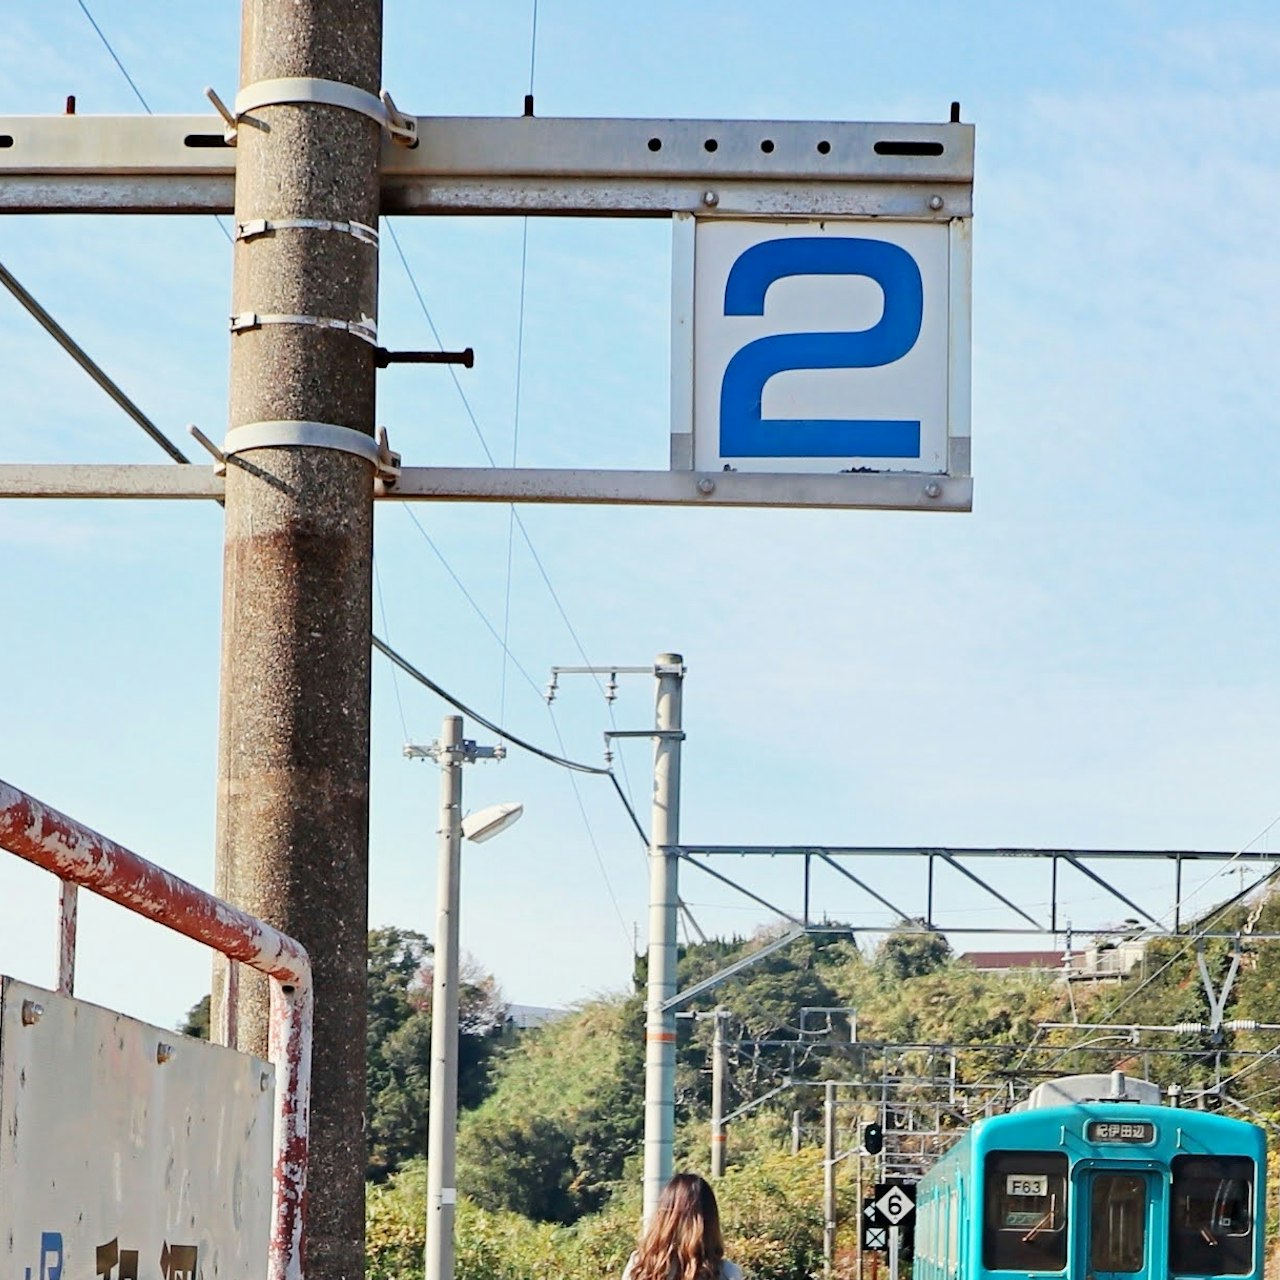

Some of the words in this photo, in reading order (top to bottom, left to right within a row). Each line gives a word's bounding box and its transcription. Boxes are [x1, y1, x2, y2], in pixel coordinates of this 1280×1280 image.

[720, 237, 924, 458] 2
[1096, 1123, 1145, 1139] 紀伊田辺
[1012, 1181, 1041, 1194] F63
[888, 1195, 902, 1216] 6
